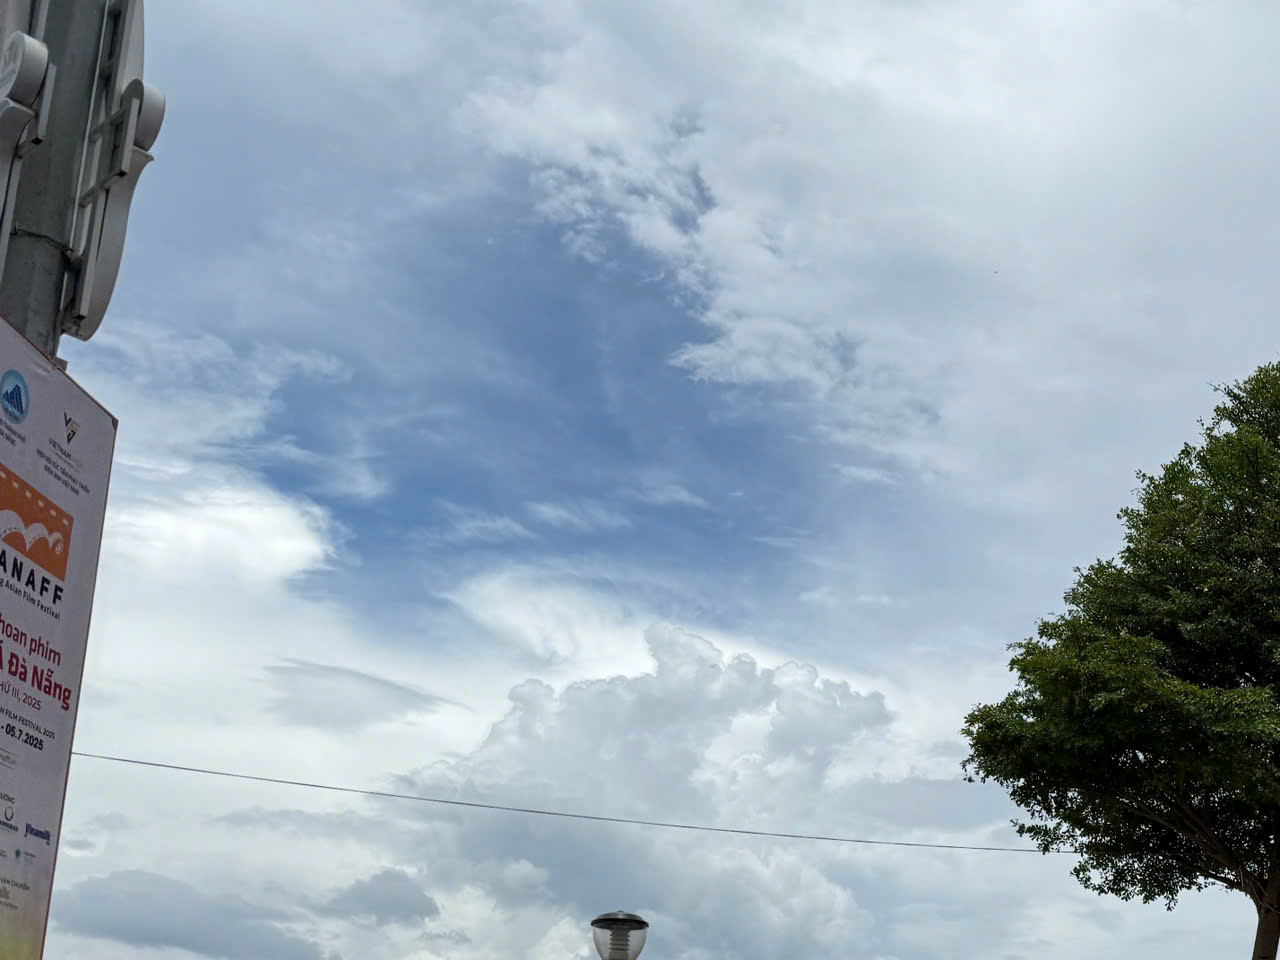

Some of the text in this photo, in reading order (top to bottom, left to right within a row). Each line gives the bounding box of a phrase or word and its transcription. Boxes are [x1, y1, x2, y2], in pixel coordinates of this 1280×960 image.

[5, 580, 22, 597] Asian
[23, 590, 36, 606] Film
[36, 600, 60, 619] Festival
[29, 635, 61, 666] phim
[8, 651, 28, 683] Đà
[32, 665, 72, 711] Nẵng
[22, 693, 42, 711] 2025
[5, 709, 18, 721] FILM
[18, 715, 42, 735] FESTIVAL
[42, 728, 56, 740] 2025
[5, 723, 44, 751] 05.7.2025
